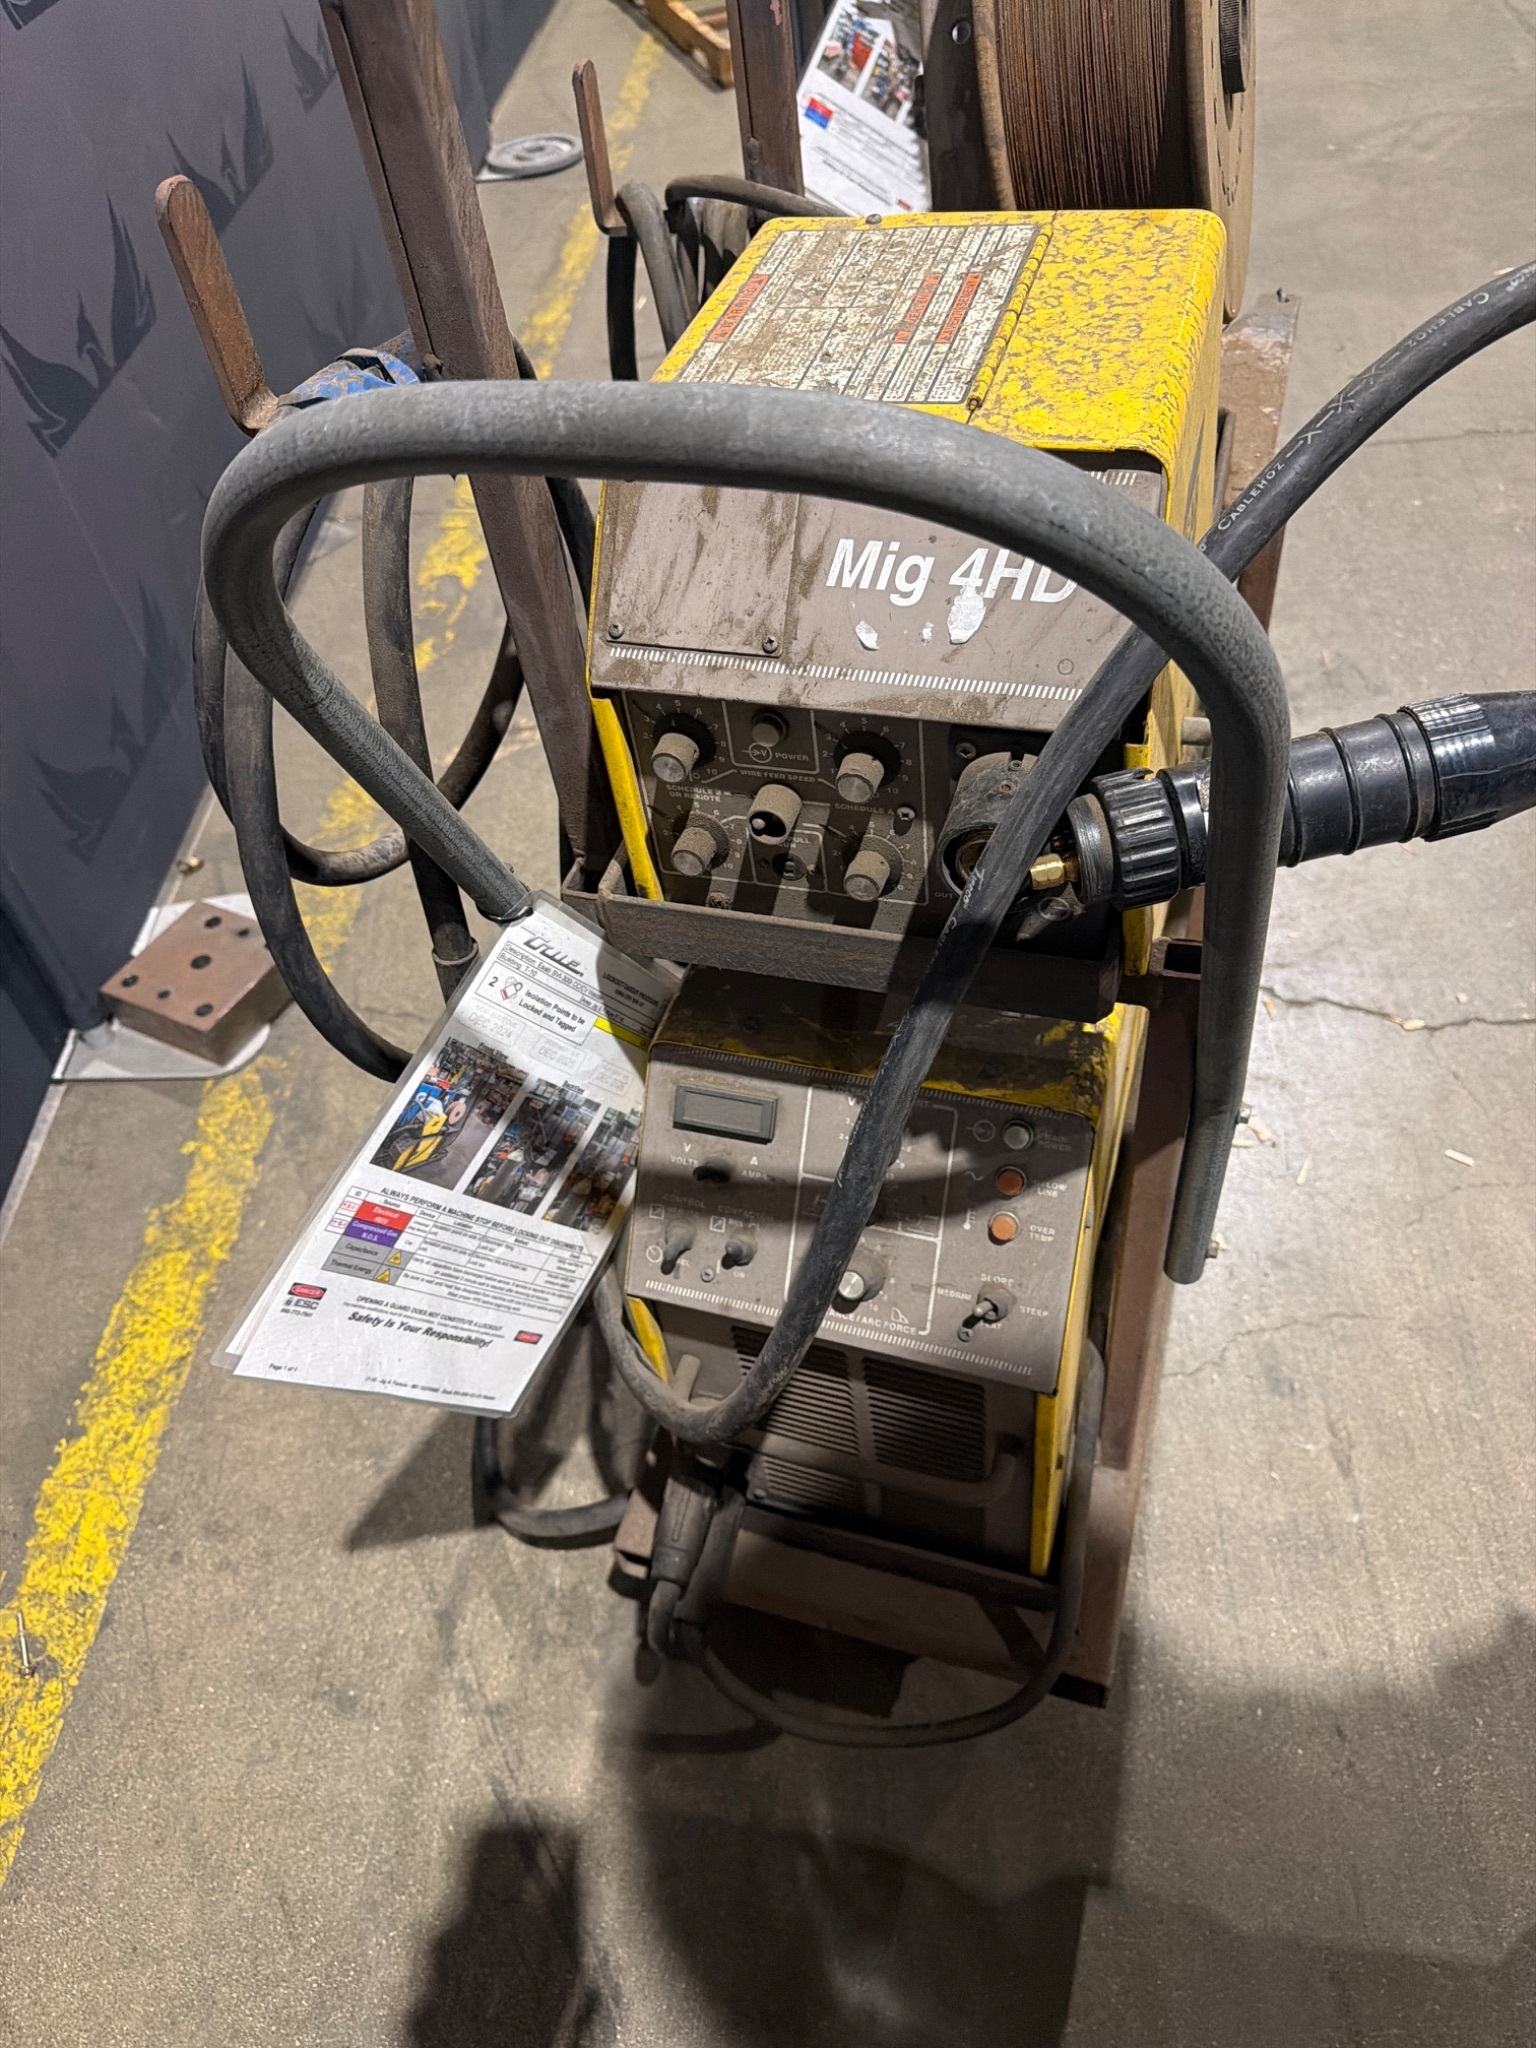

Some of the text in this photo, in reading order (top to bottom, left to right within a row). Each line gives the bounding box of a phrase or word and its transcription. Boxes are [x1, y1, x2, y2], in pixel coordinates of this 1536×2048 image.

[1217, 461, 1285, 531] CABLEHOZ
[826, 538, 1078, 607] Mig 4HD
[774, 752, 809, 762] POWER
[740, 768, 816, 784] WIRE FEED SPEED
[666, 784, 713, 795] SCHEDULE
[684, 792, 721, 803] REMOTE
[834, 802, 886, 814] SCHEDULE
[934, 891, 953, 899] OUT
[500, 951, 522, 970] Building:
[524, 964, 538, 977] T-10
[506, 943, 538, 968] Description:
[537, 961, 551, 975] Esab
[488, 976, 499, 988] 2
[525, 989, 552, 1009] Isolation
[552, 1002, 572, 1019] Points
[468, 1012, 490, 1029] DEC
[518, 999, 543, 1017] Locked
[543, 1010, 555, 1023] and
[555, 1016, 577, 1033] Tagged
[683, 1142, 692, 1153] V
[670, 1155, 699, 1168] VOLTS
[750, 1155, 759, 1166] A
[742, 1169, 767, 1180] AMPS
[380, 1187, 411, 1201] ALWAYS
[409, 1194, 442, 1210] PERFORM
[447, 1207, 476, 1221] MACHINE
[475, 1215, 492, 1226] STOP
[491, 1220, 515, 1233] BEFORE
[383, 1199, 401, 1209] Source
[419, 1208, 436, 1220] Device
[352, 1220, 387, 1236] Compressed
[1030, 1224, 1056, 1236] OVER
[1030, 1232, 1055, 1243] TEMP
[345, 1242, 379, 1257] Capacitance
[352, 1264, 373, 1276] Energy
[980, 1272, 1014, 1287] SLOPE
[937, 1287, 972, 1300] MEDIUM
[294, 1298, 319, 1310] ESC
[356, 1294, 384, 1308] OPENING
[389, 1301, 411, 1313] GUARD
[410, 1305, 427, 1316] DOES
[1020, 1305, 1049, 1317] STEEP
[348, 1311, 493, 1349] Safety Is Your Responsibility!
[882, 1320, 917, 1336] FORCE
